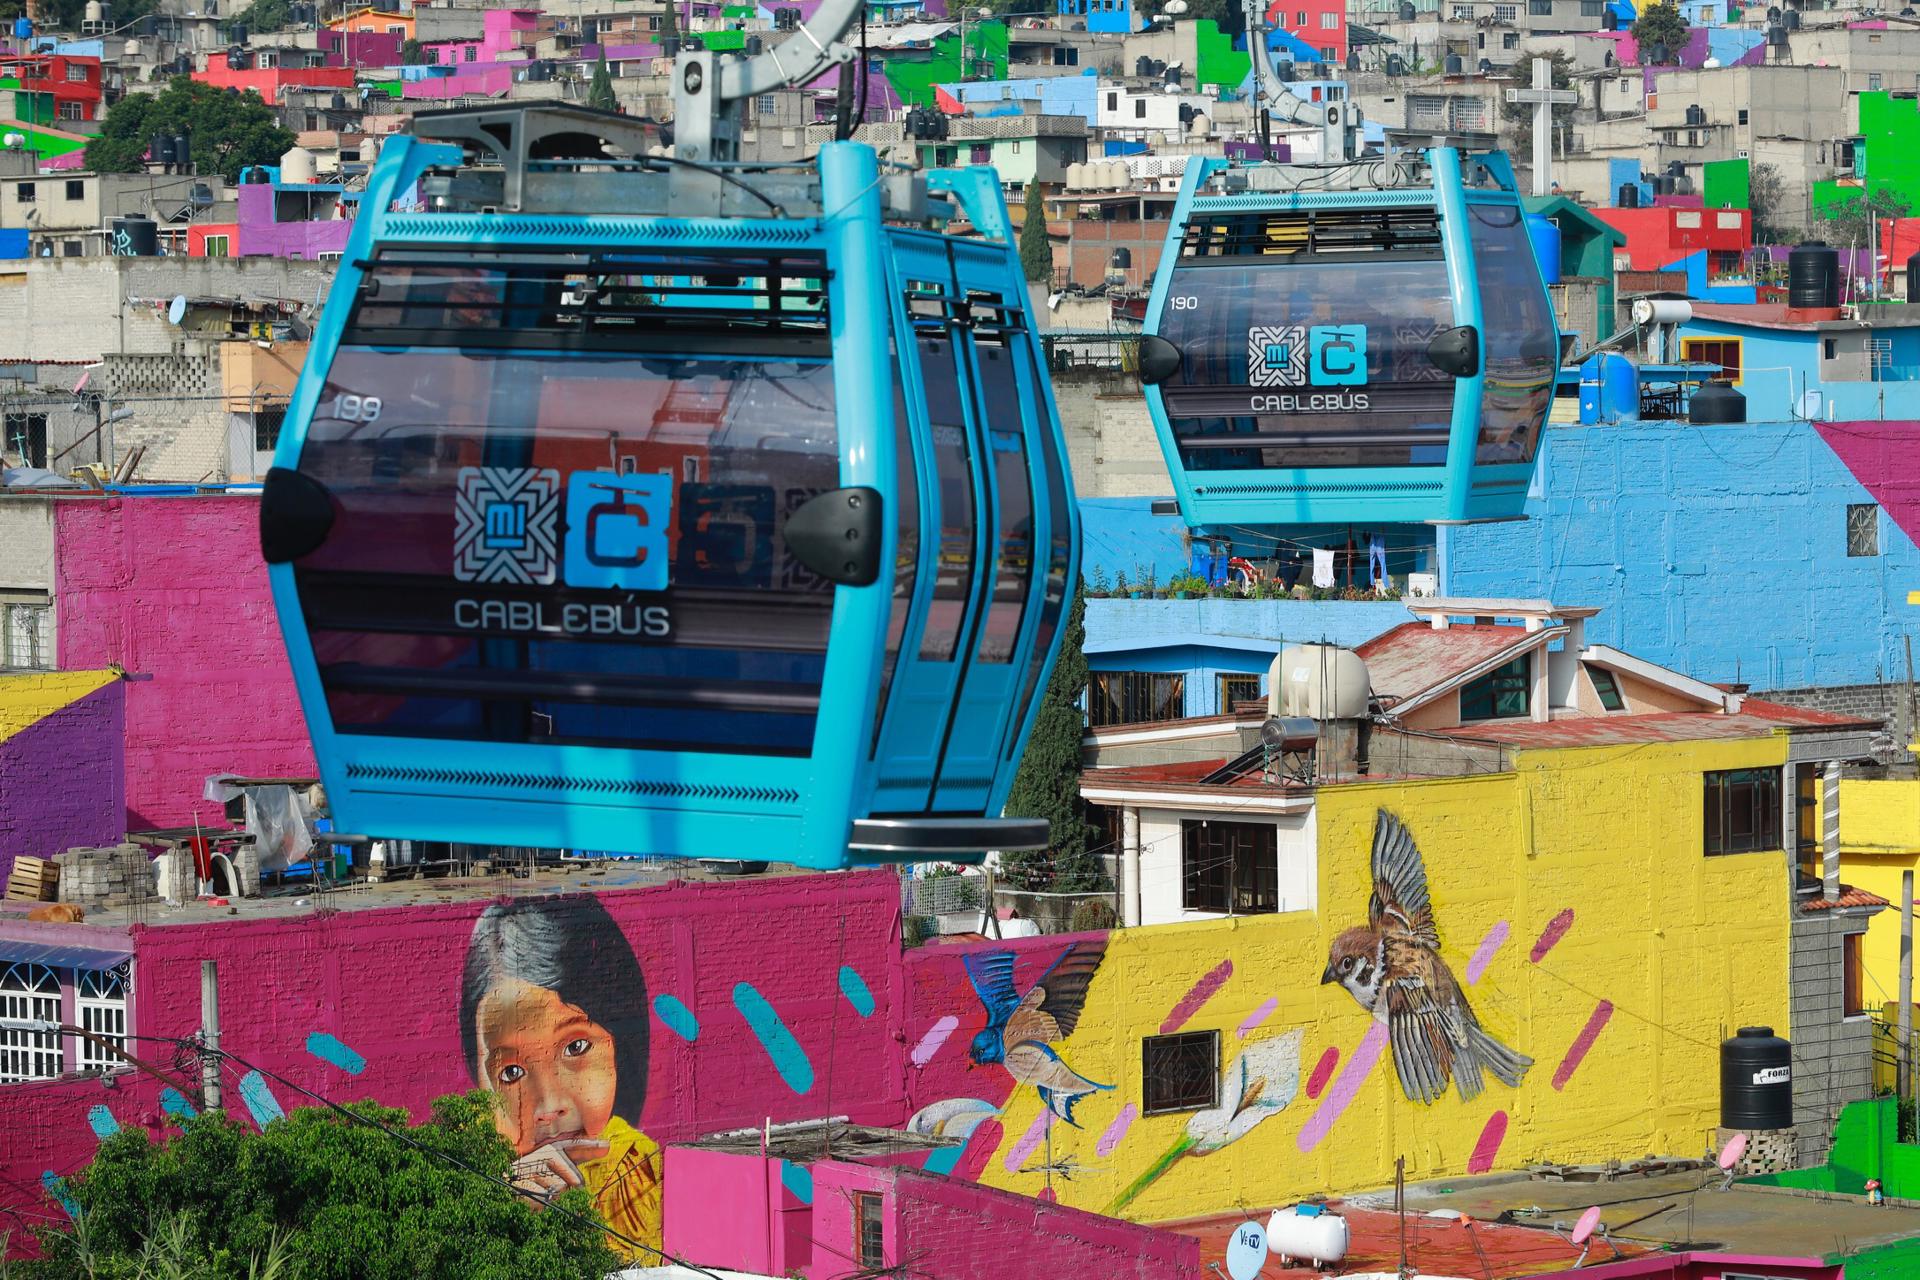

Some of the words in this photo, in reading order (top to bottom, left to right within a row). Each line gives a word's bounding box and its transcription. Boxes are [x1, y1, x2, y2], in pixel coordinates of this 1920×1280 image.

[1170, 296, 1198, 310] 190
[333, 394, 382, 422] 199
[1250, 388, 1369, 411] CABLEBÚS
[454, 594, 670, 636] CABLEBÚS
